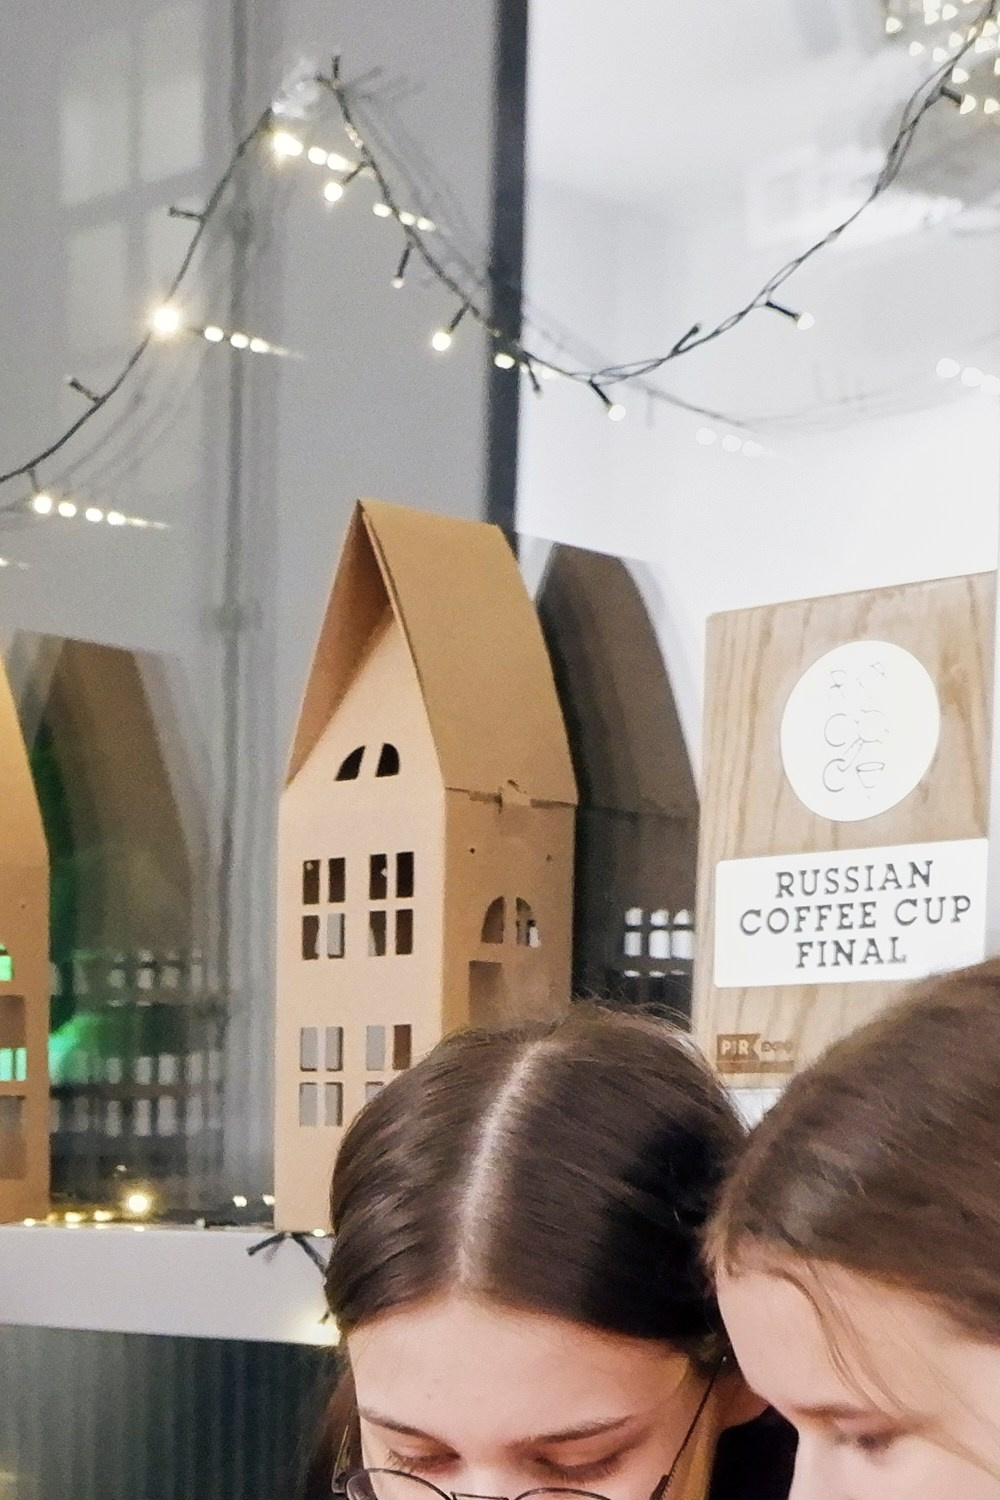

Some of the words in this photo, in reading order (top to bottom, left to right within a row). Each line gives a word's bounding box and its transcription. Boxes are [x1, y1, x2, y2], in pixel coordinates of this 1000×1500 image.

[775, 860, 934, 898] RUSSIAN
[739, 901, 877, 936] COFFEE
[894, 895, 971, 926] CUP
[795, 936, 908, 969] FINAL
